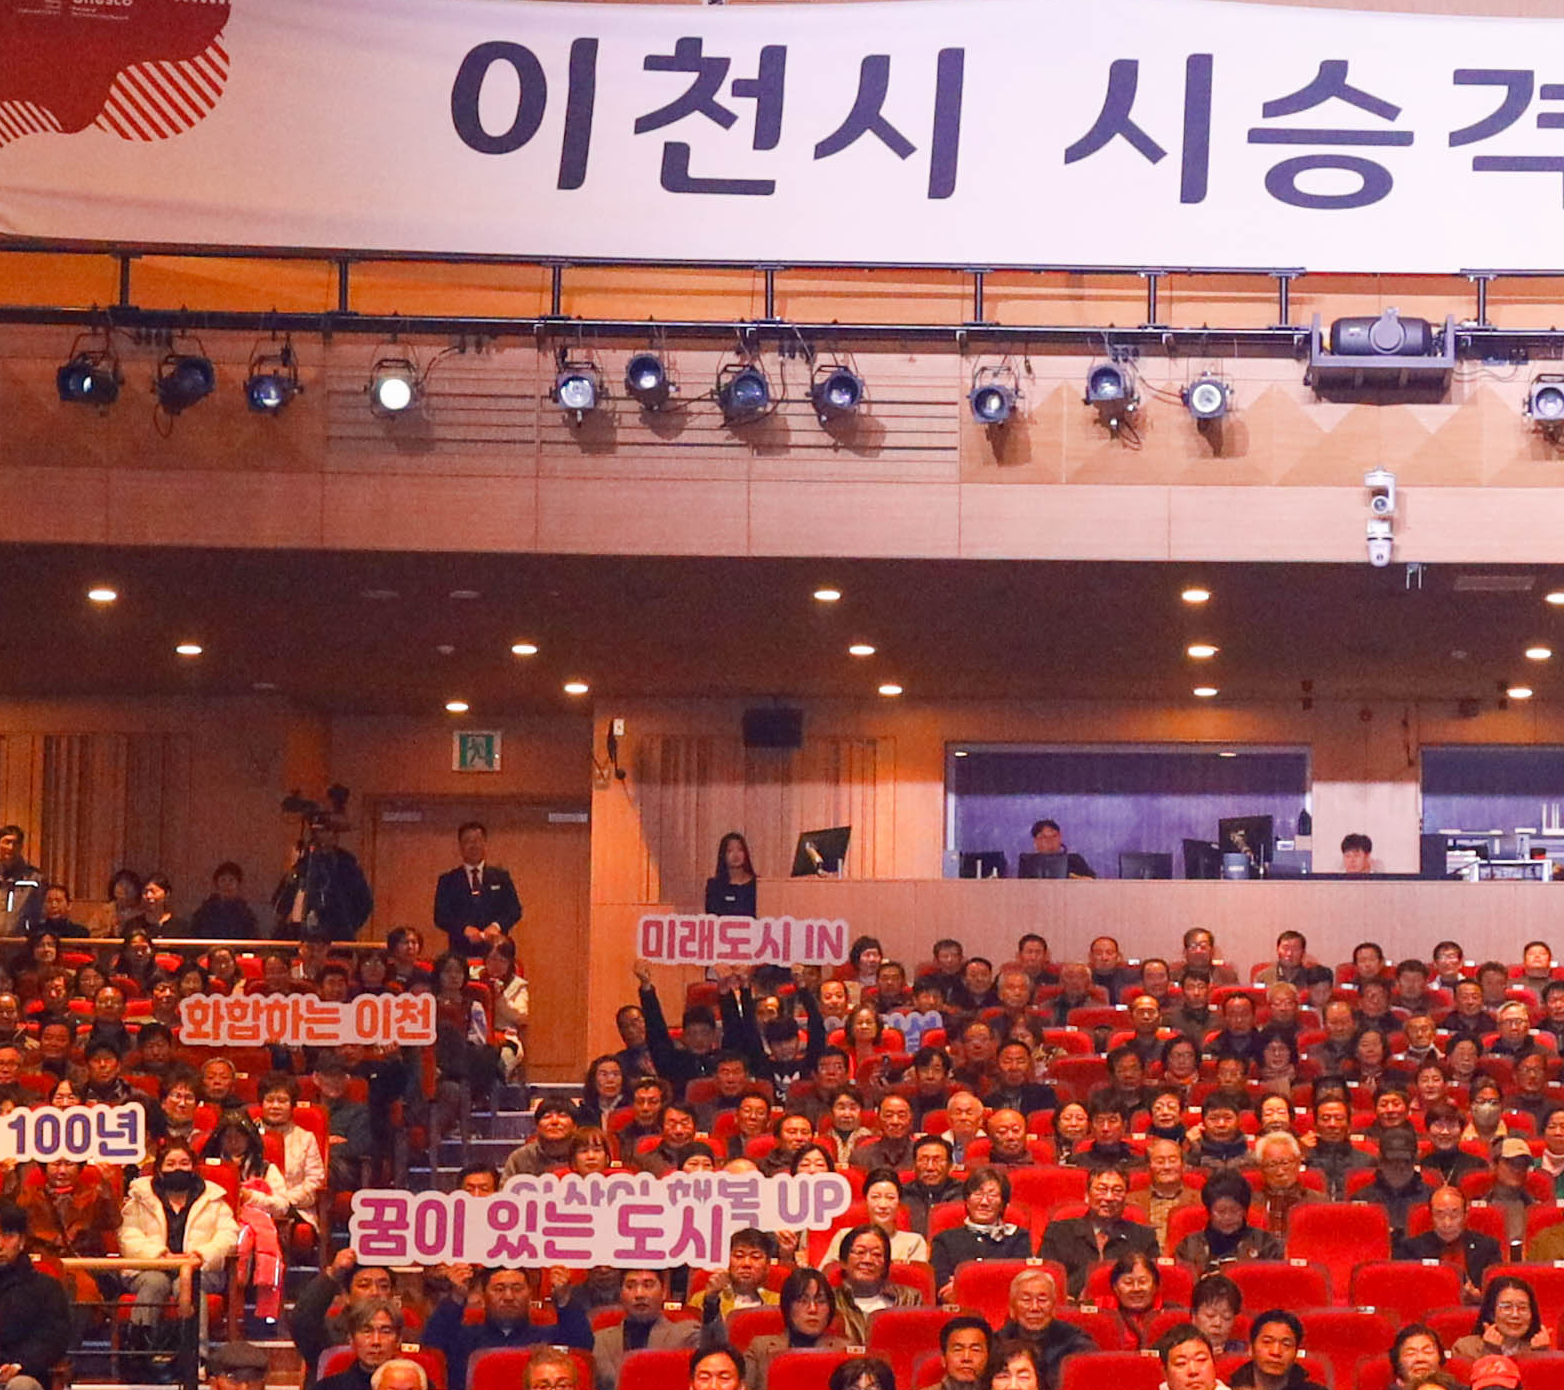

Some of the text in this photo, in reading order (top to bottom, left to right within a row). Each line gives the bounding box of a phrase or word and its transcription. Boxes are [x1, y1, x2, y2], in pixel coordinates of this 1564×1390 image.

[452, 36, 969, 201] 이천시
[641, 918, 844, 963] 미래도시 IN
[185, 995, 434, 1043] 화합하는 이천
[7, 1107, 138, 1160] 100년
[777, 1179, 846, 1225] UP
[359, 1197, 724, 1263] 꿈이 있는 도시
